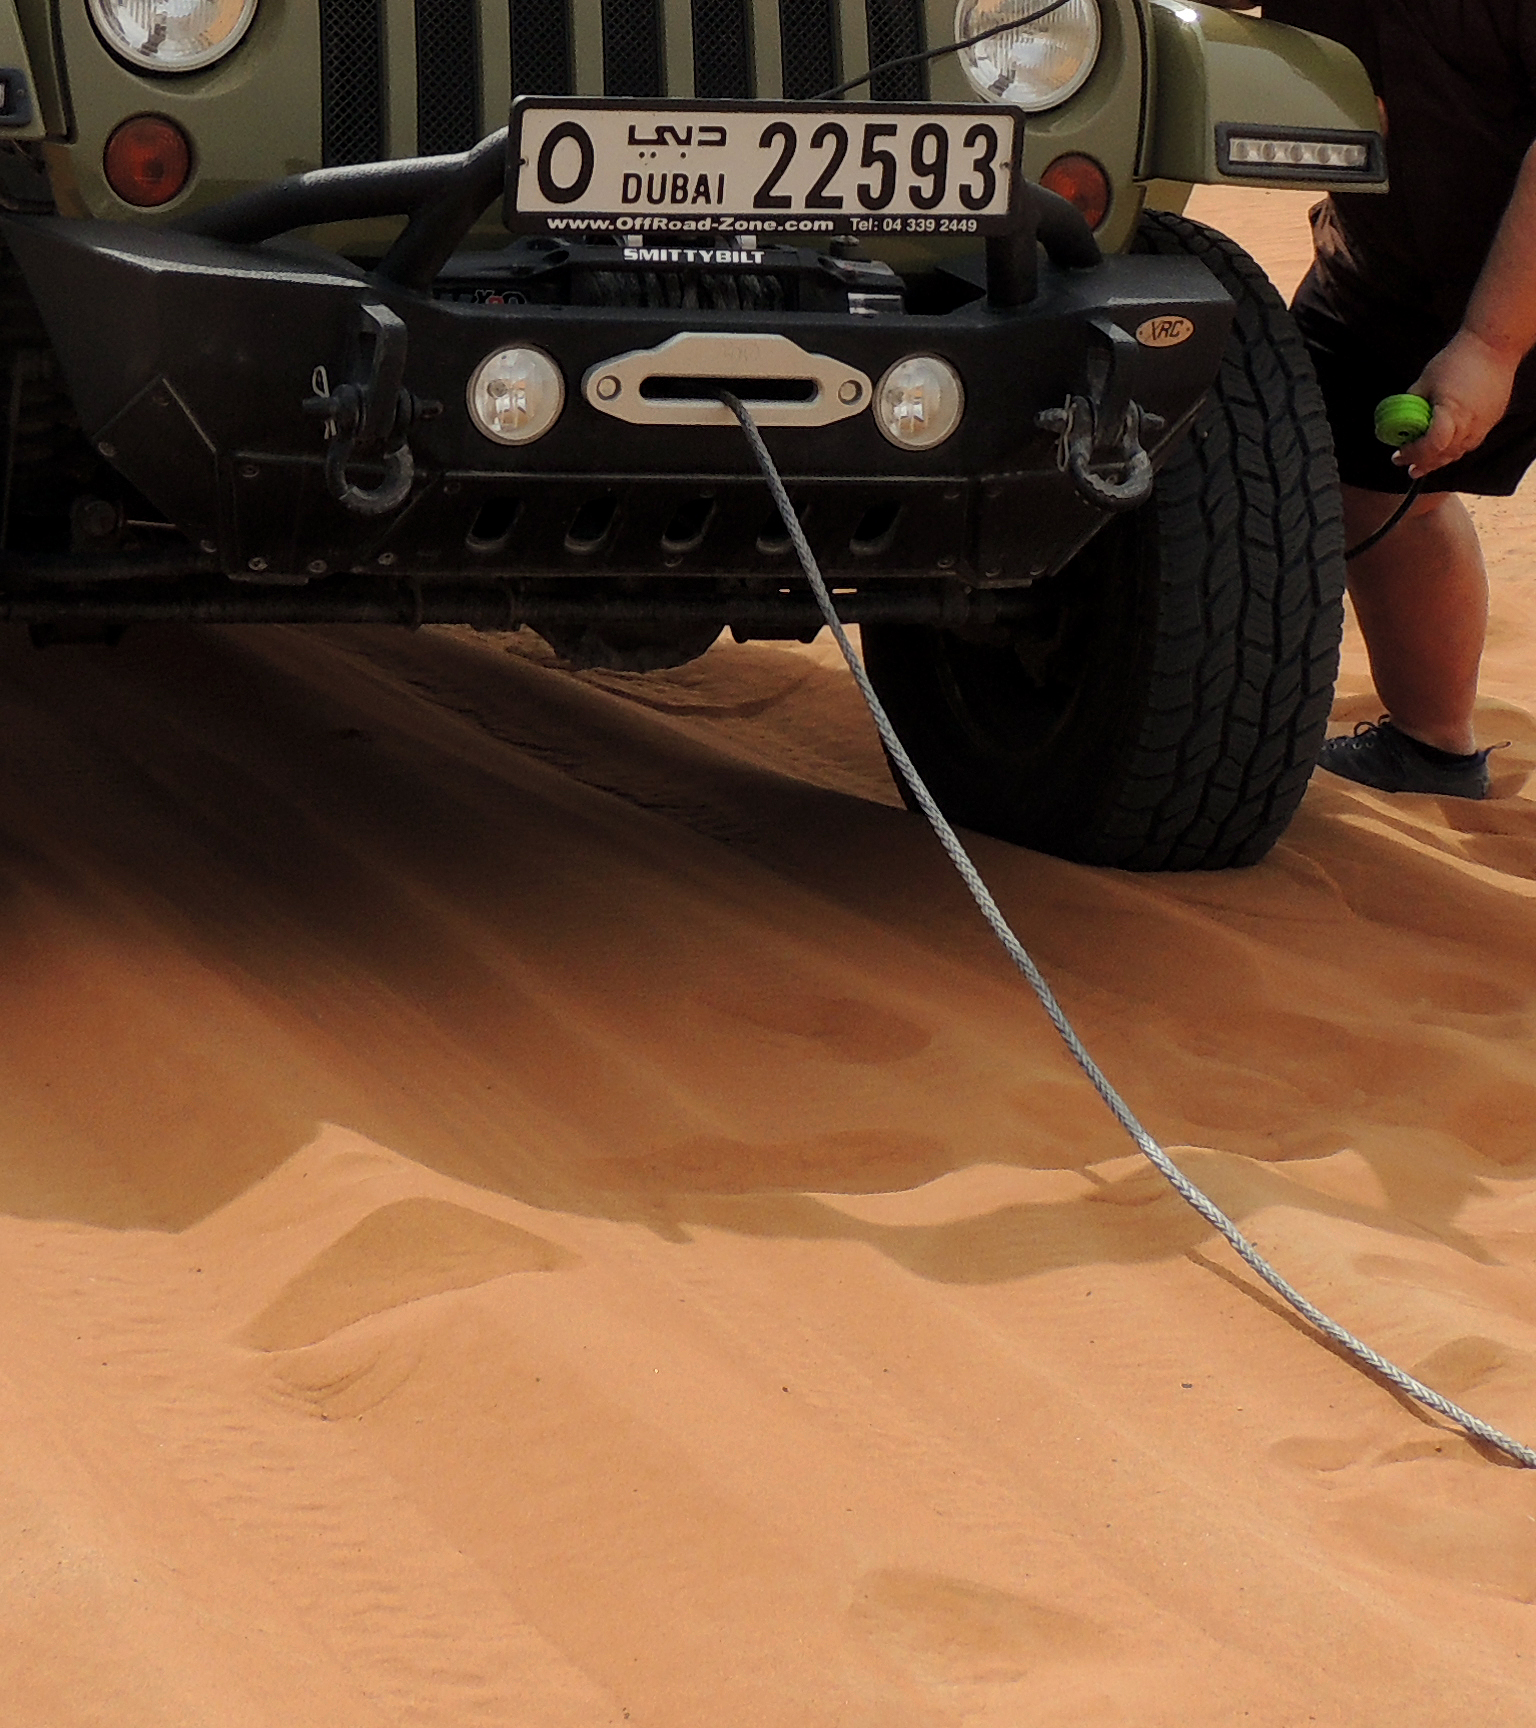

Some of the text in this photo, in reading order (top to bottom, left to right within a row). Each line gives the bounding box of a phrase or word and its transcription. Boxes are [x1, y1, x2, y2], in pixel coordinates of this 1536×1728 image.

[627, 124, 727, 160] دبي
[753, 121, 998, 211] 22593
[621, 172, 725, 205] DUBAI
[547, 216, 978, 233] www.OffRoad-Zone.com Tel: 04 339 2449
[623, 247, 764, 265] SMITTYBILT
